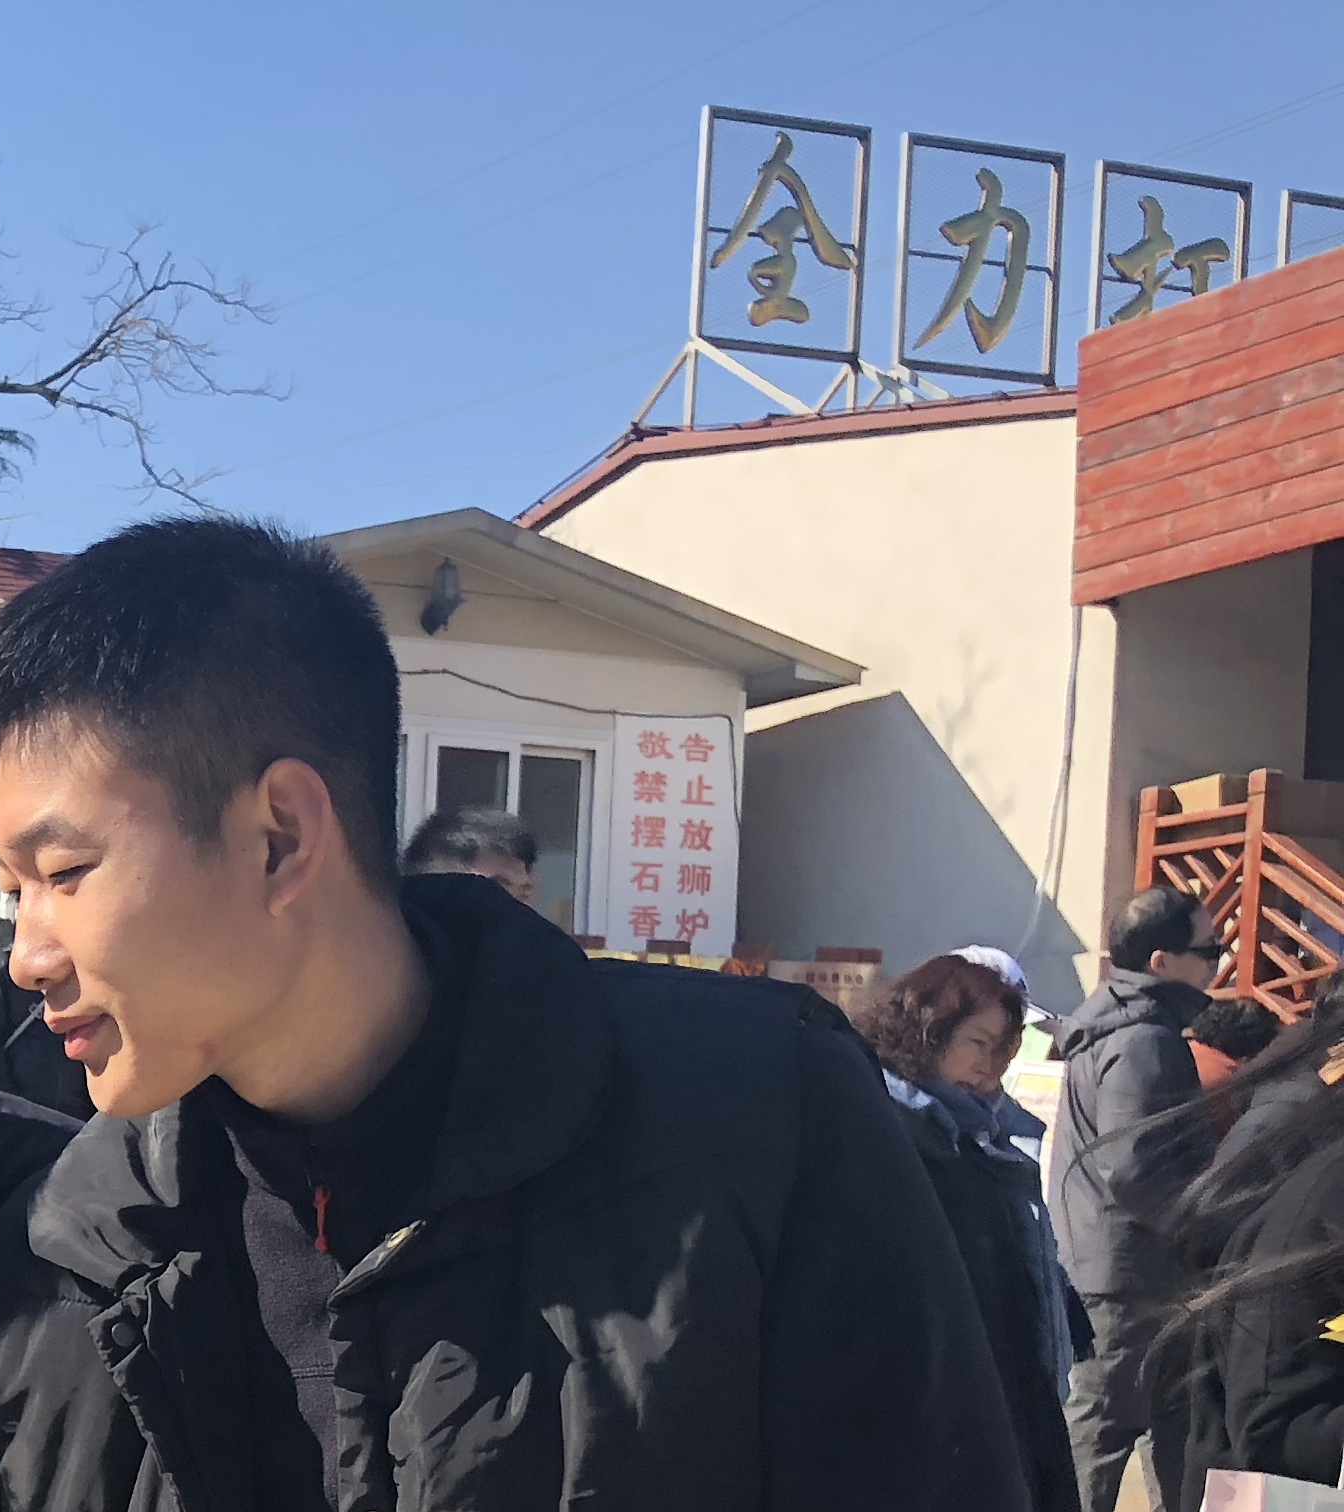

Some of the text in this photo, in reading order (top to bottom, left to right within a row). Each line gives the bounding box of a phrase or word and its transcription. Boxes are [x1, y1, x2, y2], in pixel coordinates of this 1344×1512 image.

[711, 130, 1231, 355] 全力打
[637, 729, 715, 763] 敬告
[633, 770, 716, 807] 禁止
[631, 815, 714, 851] 摆放
[630, 861, 712, 896] 石狮
[628, 905, 709, 941] 香炉
